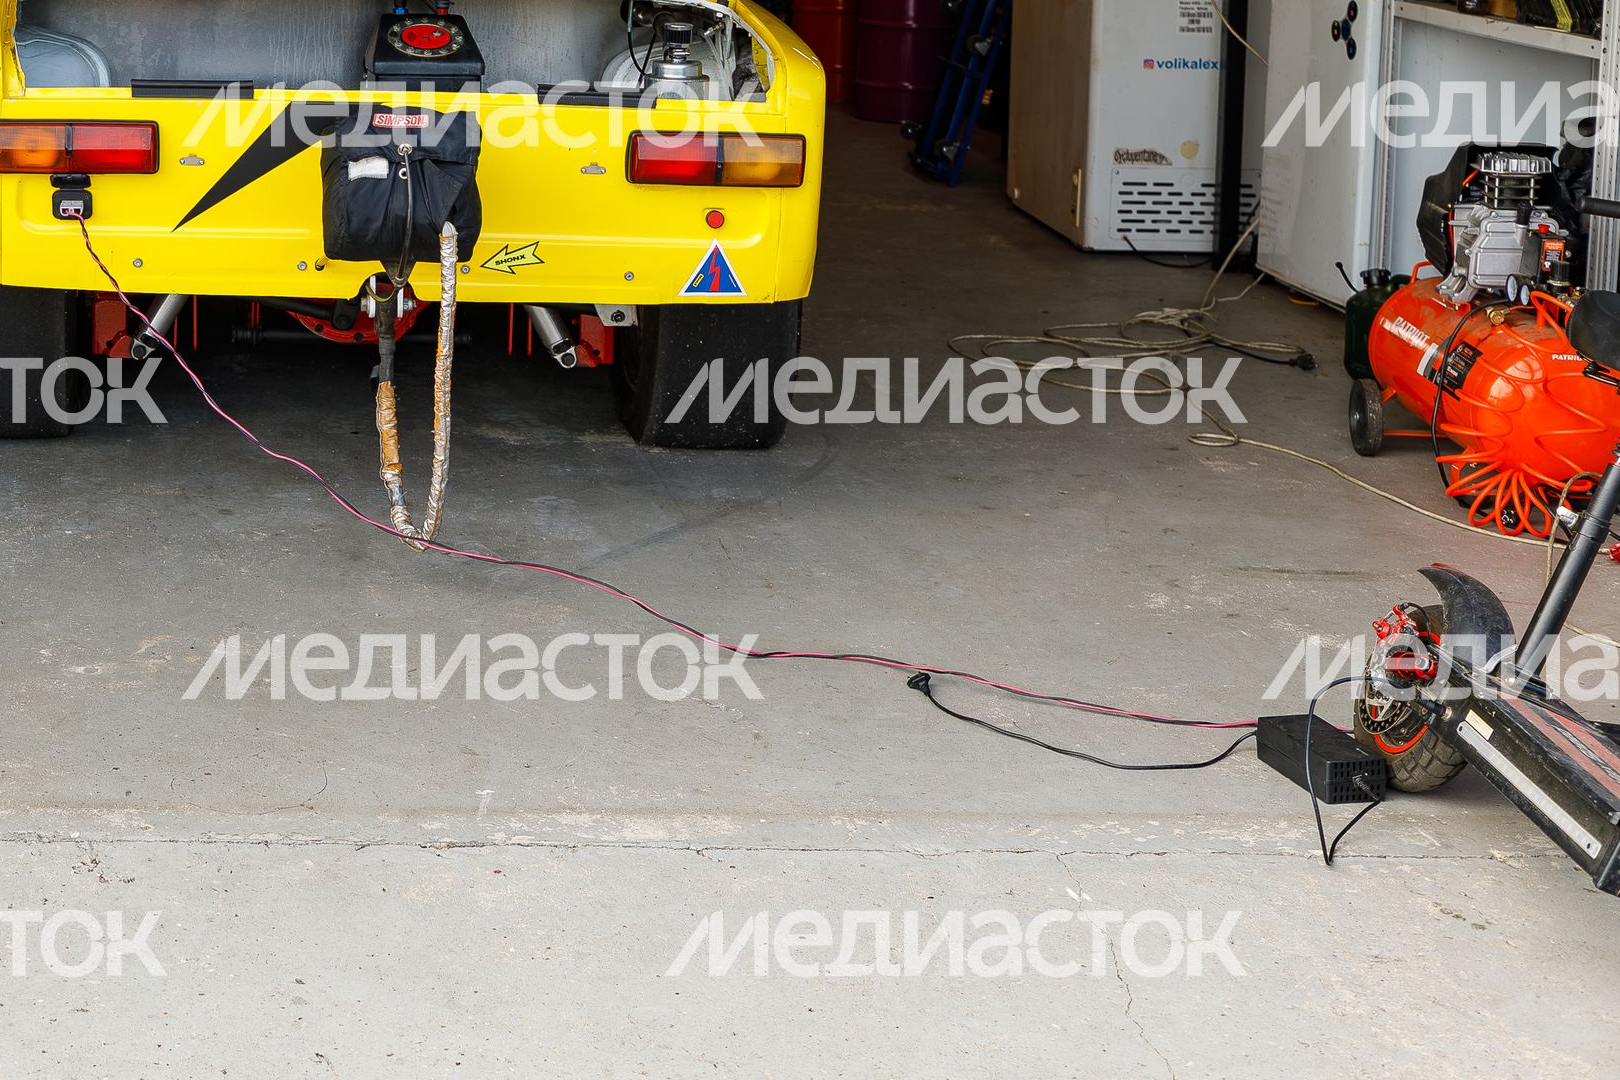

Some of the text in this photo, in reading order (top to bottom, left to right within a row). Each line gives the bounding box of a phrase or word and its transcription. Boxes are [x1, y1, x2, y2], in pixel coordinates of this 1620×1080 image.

[1157, 58, 1219, 69] volikalex
[376, 114, 424, 125] SIMPSON
[495, 254, 526, 265] SHONX
